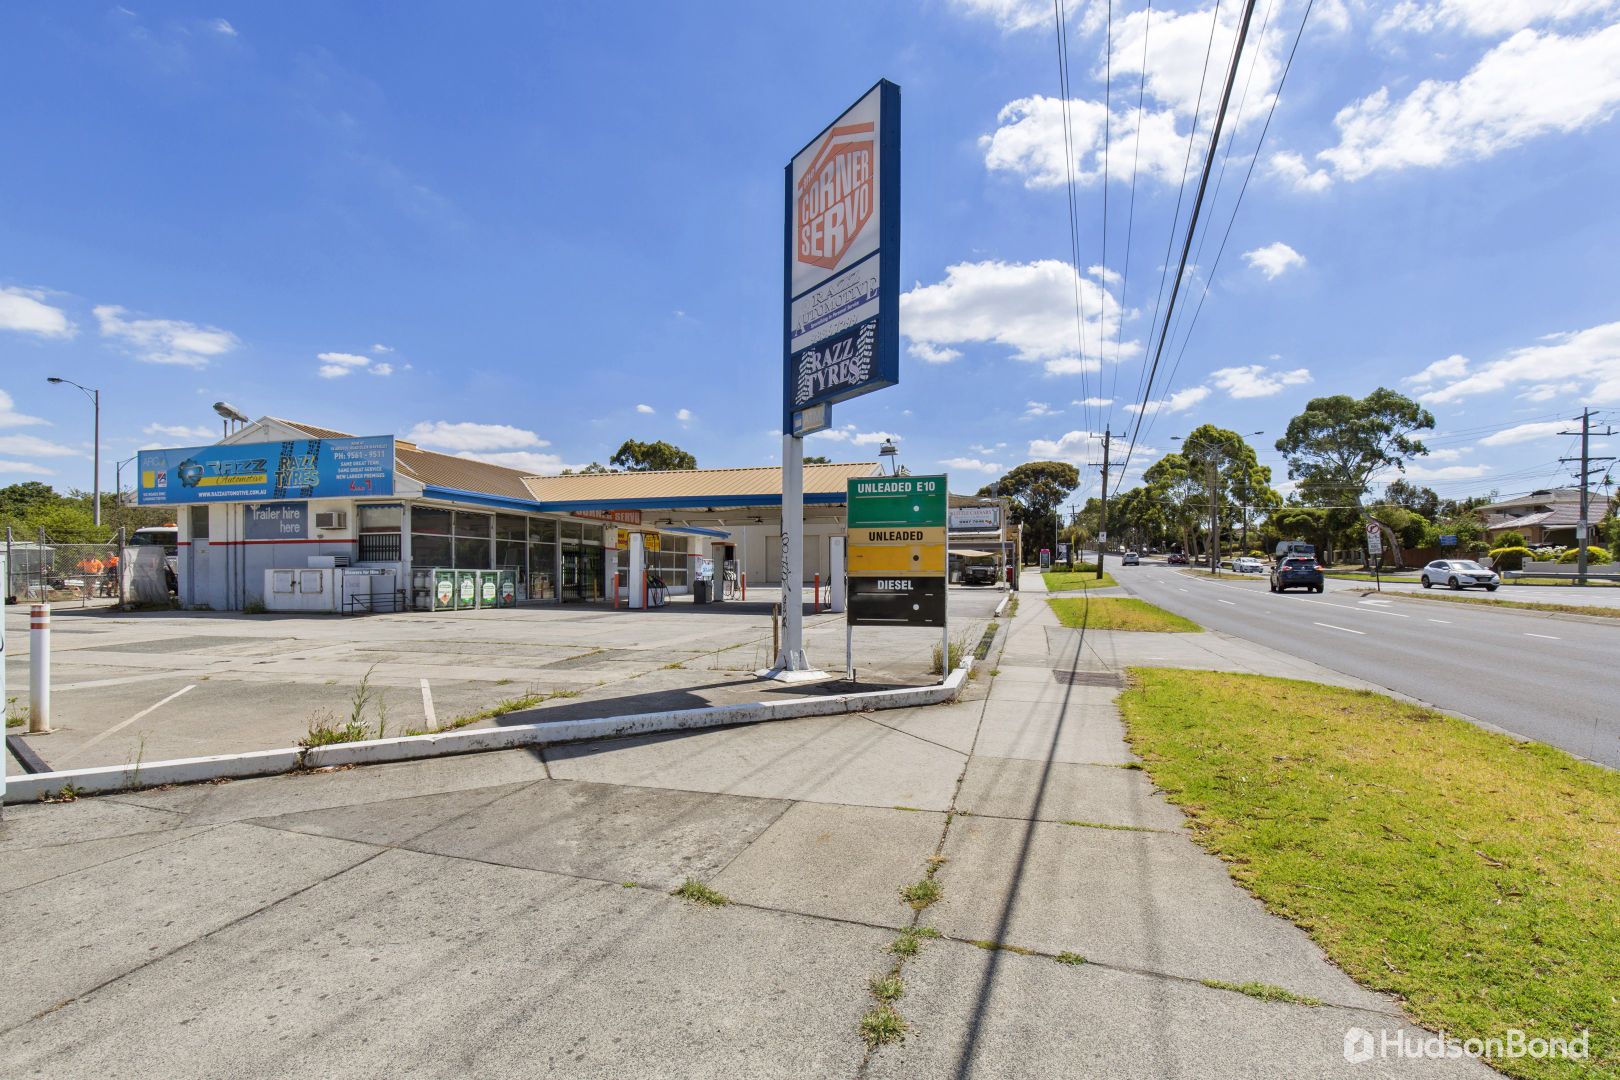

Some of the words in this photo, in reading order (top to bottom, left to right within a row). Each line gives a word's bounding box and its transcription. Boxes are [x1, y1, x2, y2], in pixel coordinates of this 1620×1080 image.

[802, 150, 869, 224] CORNER
[801, 183, 869, 257] SERVO
[811, 338, 853, 373] RAZZ
[807, 356, 861, 399] TYRES
[280, 454, 316, 471] RAZZ
[274, 469, 321, 488] TYRES
[858, 482, 912, 494] UNLEADED
[916, 481, 936, 492] E10
[251, 504, 281, 520] Trailer
[282, 507, 300, 519] hire
[280, 521, 300, 533] here
[868, 531, 924, 541] UNLEADED
[877, 580, 914, 590] DIESEL
